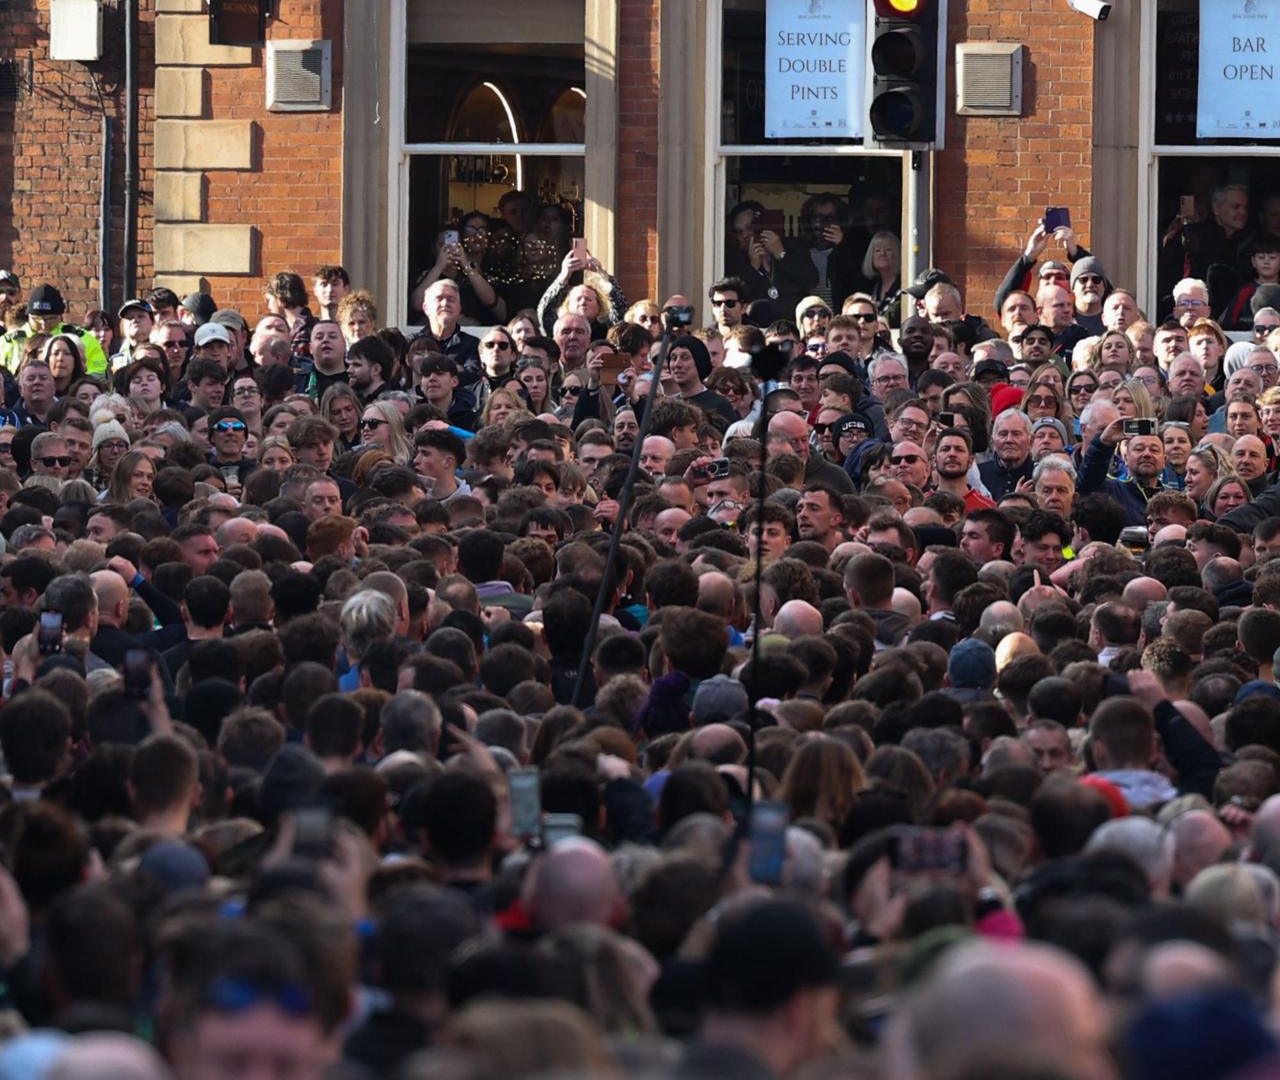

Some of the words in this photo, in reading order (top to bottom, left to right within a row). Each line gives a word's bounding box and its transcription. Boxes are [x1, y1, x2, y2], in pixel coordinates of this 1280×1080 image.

[777, 30, 852, 47] SERVING
[1231, 36, 1267, 53] BAR
[778, 57, 847, 73] DOUBLE
[1223, 64, 1274, 81] OPEN
[791, 84, 839, 100] PINTS
